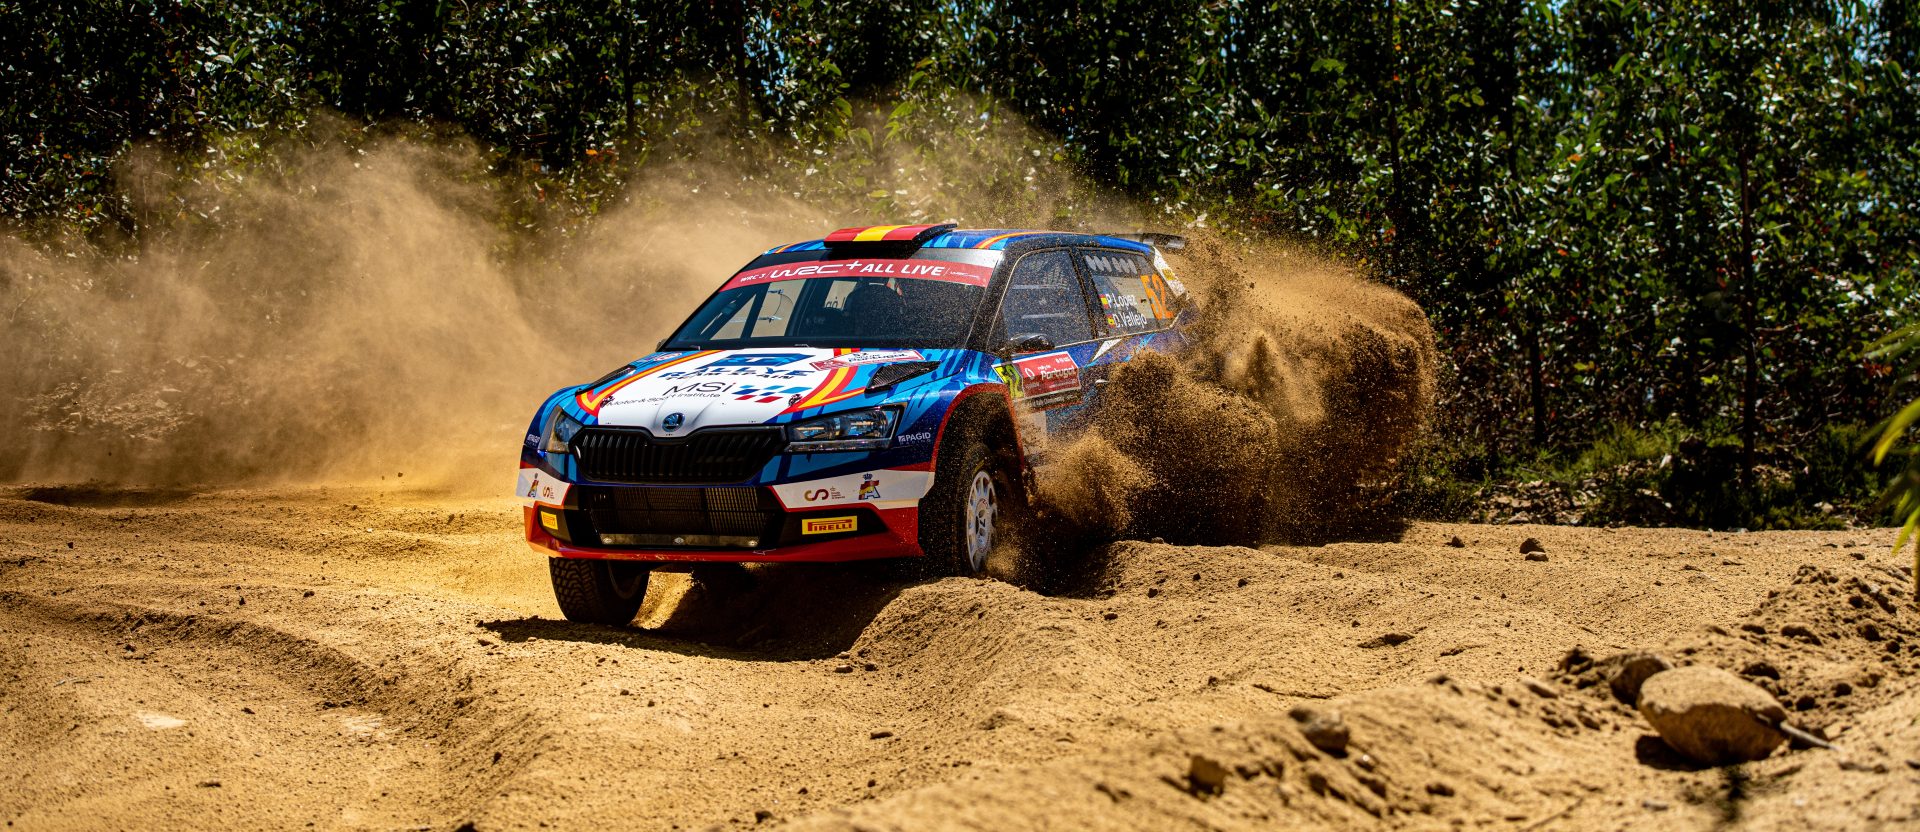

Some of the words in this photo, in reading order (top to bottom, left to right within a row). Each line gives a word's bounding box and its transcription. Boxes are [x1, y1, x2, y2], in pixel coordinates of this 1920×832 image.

[859, 263, 895, 273] ALL
[901, 264, 945, 276] LIVE
[1140, 273, 1174, 320] 52
[657, 366, 816, 379] RALLYE
[1040, 366, 1076, 380] Portugal
[905, 432, 931, 441] PAGID
[807, 519, 853, 532] PIRELLI
